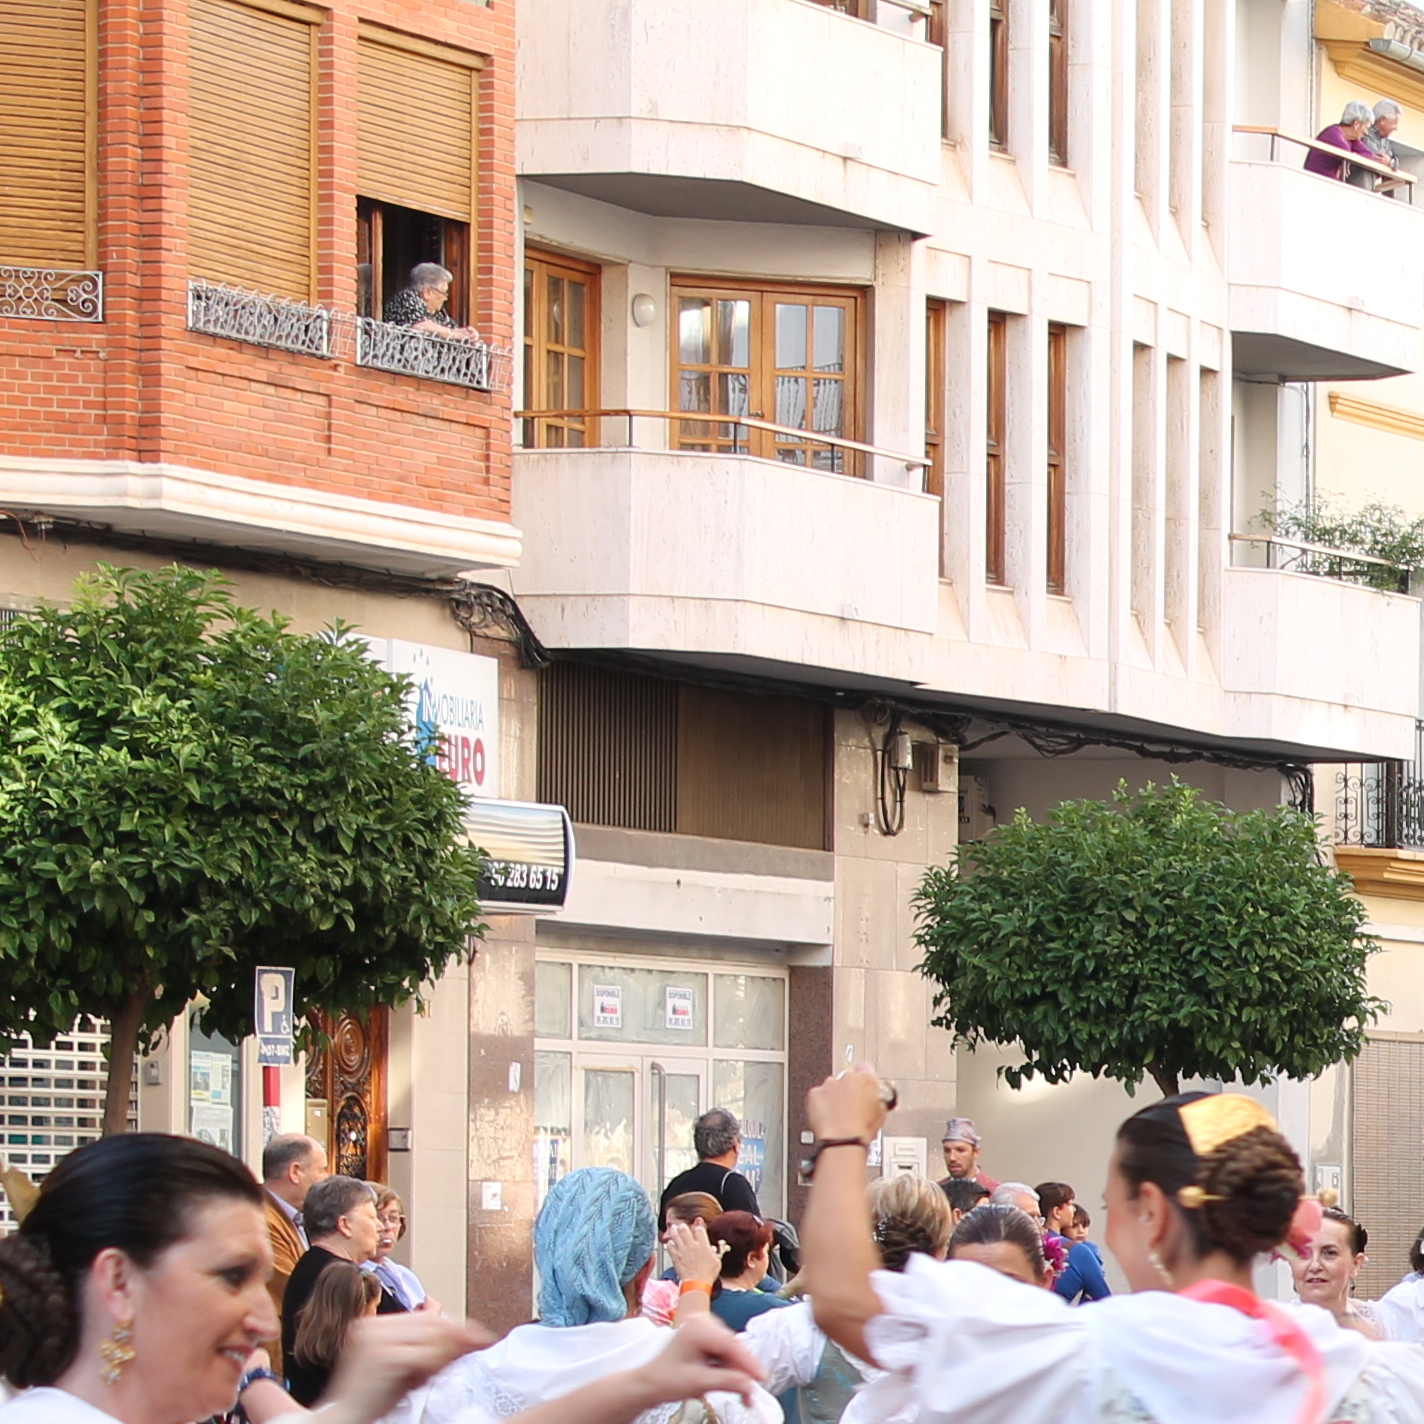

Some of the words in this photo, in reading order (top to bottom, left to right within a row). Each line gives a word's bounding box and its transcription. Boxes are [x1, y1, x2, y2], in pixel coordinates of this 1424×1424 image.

[436, 734, 486, 787] EURO
[507, 863, 528, 888] 283
[529, 865, 544, 890] 65
[546, 867, 560, 891] 15
[260, 973, 286, 1034] P
